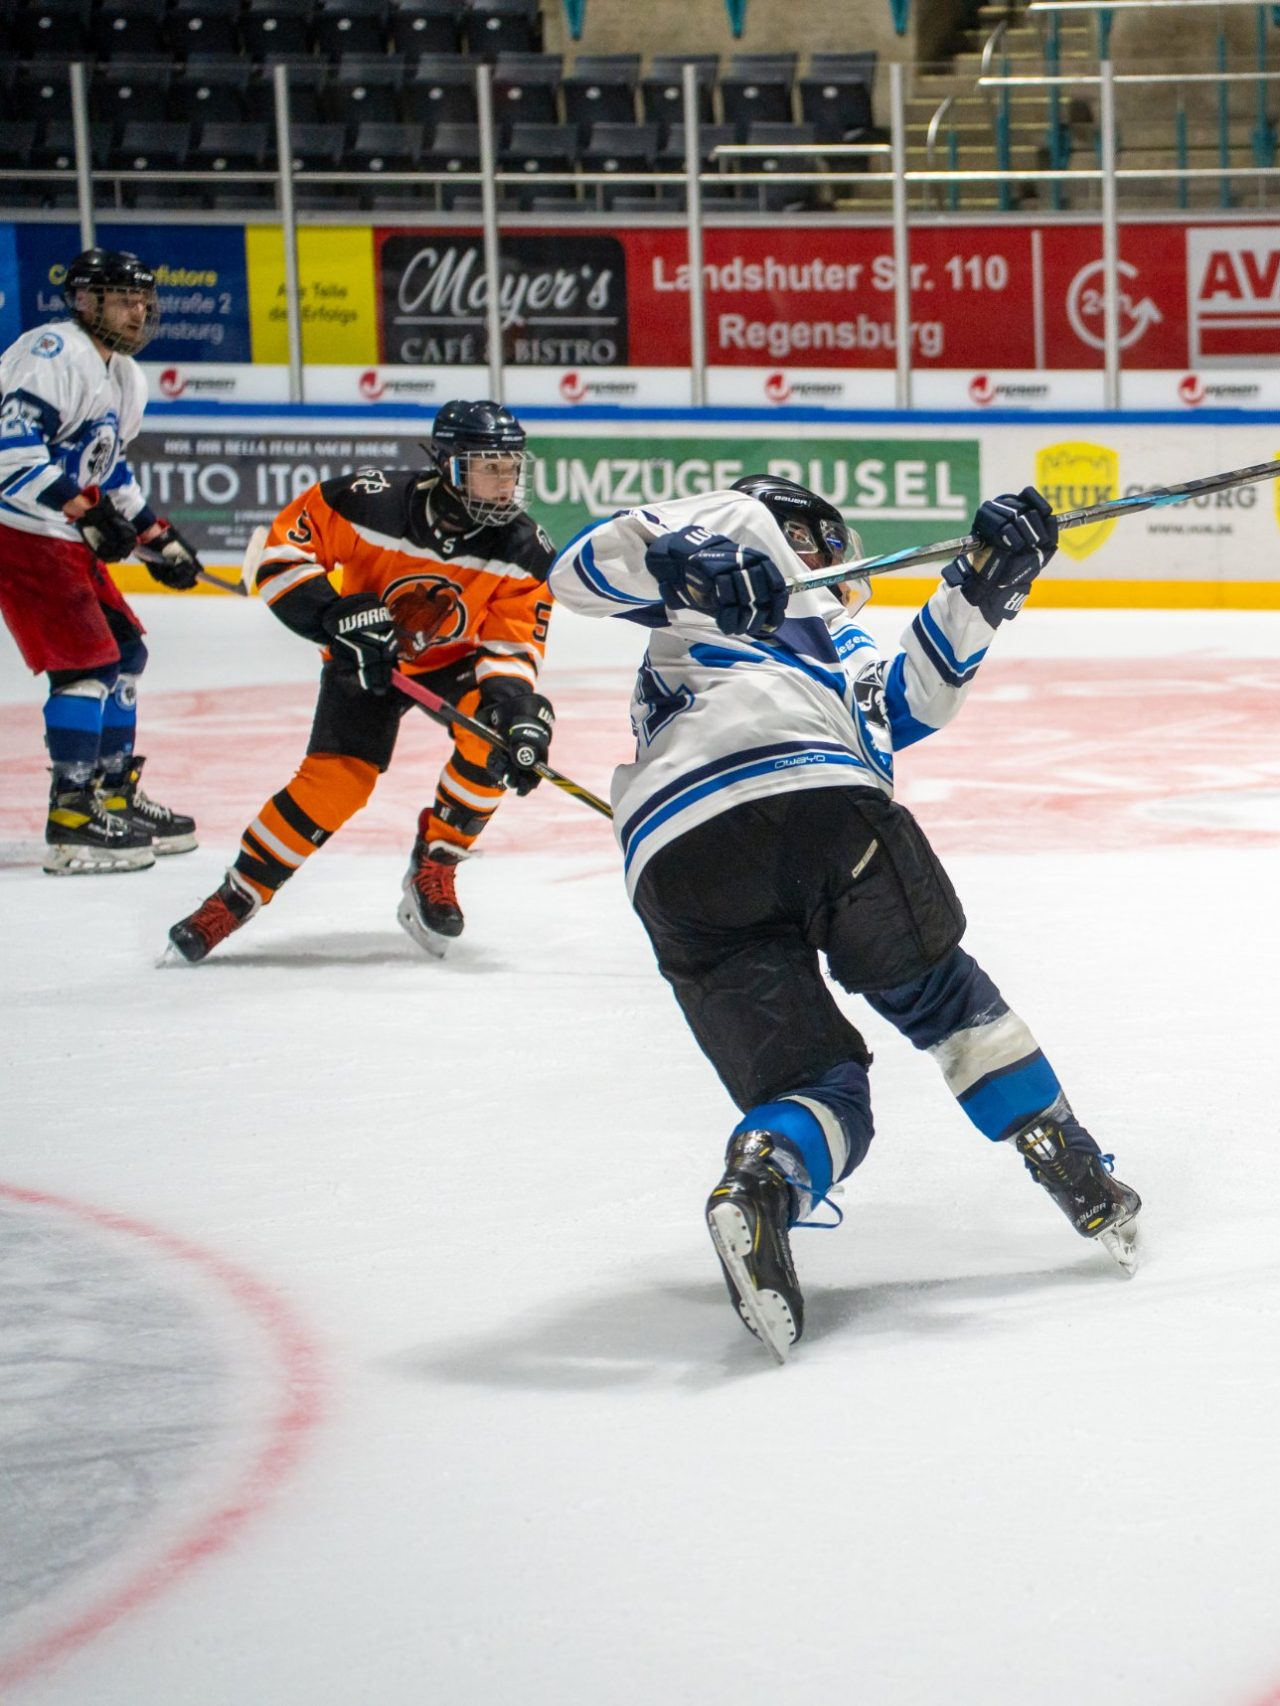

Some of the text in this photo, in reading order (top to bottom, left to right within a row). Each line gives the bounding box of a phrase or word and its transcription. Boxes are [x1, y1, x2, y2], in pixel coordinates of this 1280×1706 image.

[399, 247, 613, 330] Mayer's
[652, 255, 1009, 290] Landshuter Sr. 110
[400, 334, 617, 365] CAFÉ BISTRO
[534, 457, 744, 505] UMZÜGE
[1042, 484, 1112, 510] HUK
